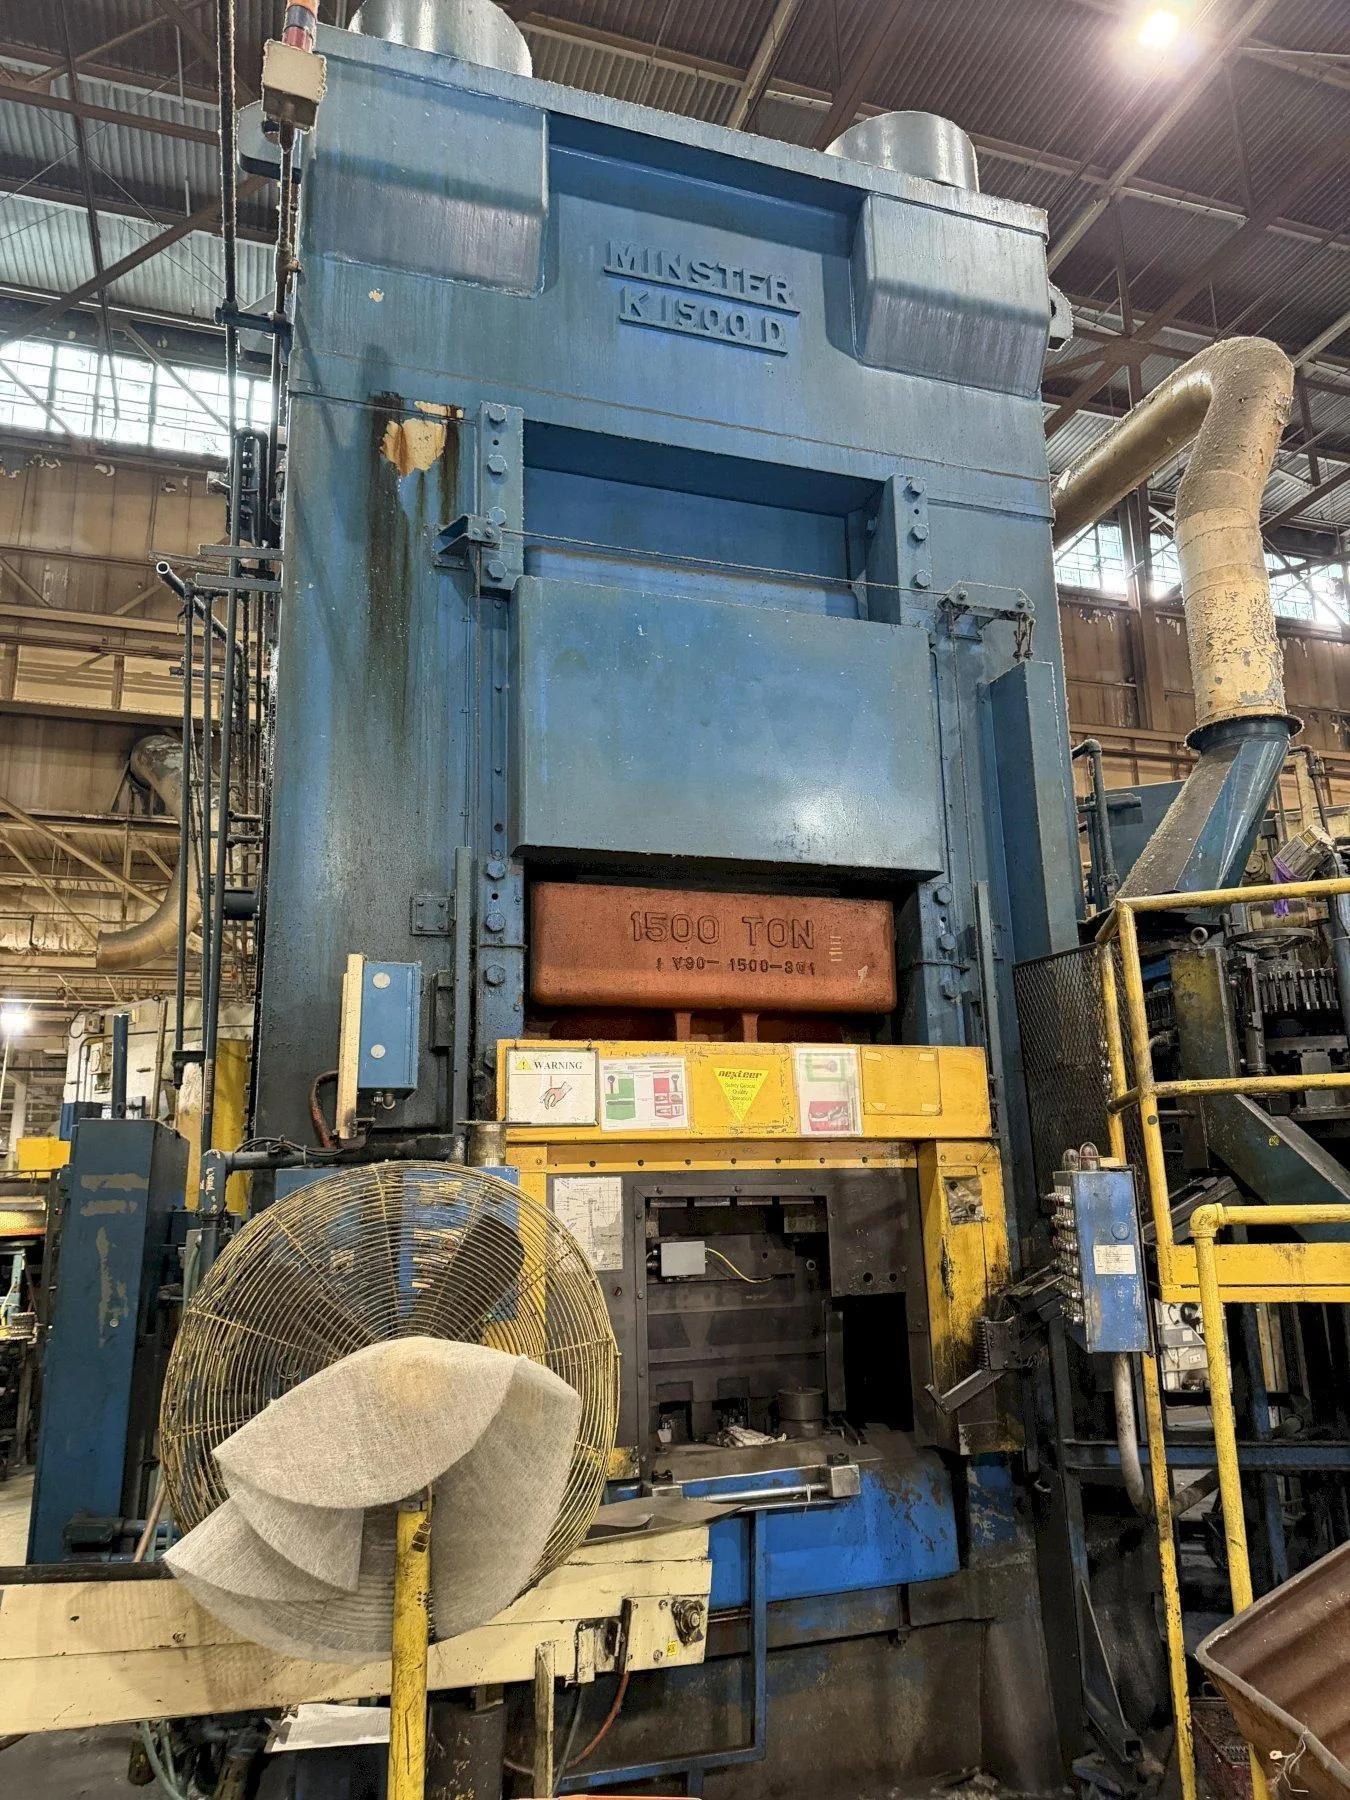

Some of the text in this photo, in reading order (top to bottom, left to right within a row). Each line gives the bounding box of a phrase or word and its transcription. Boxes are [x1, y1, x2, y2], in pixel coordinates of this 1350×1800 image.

[607, 240, 794, 304] MINSTER
[622, 285, 650, 318] K
[760, 315, 787, 349] D
[631, 911, 815, 949] 1500 TON
[534, 1061, 583, 1070] WARNING
[718, 1070, 762, 1079] nexteer
